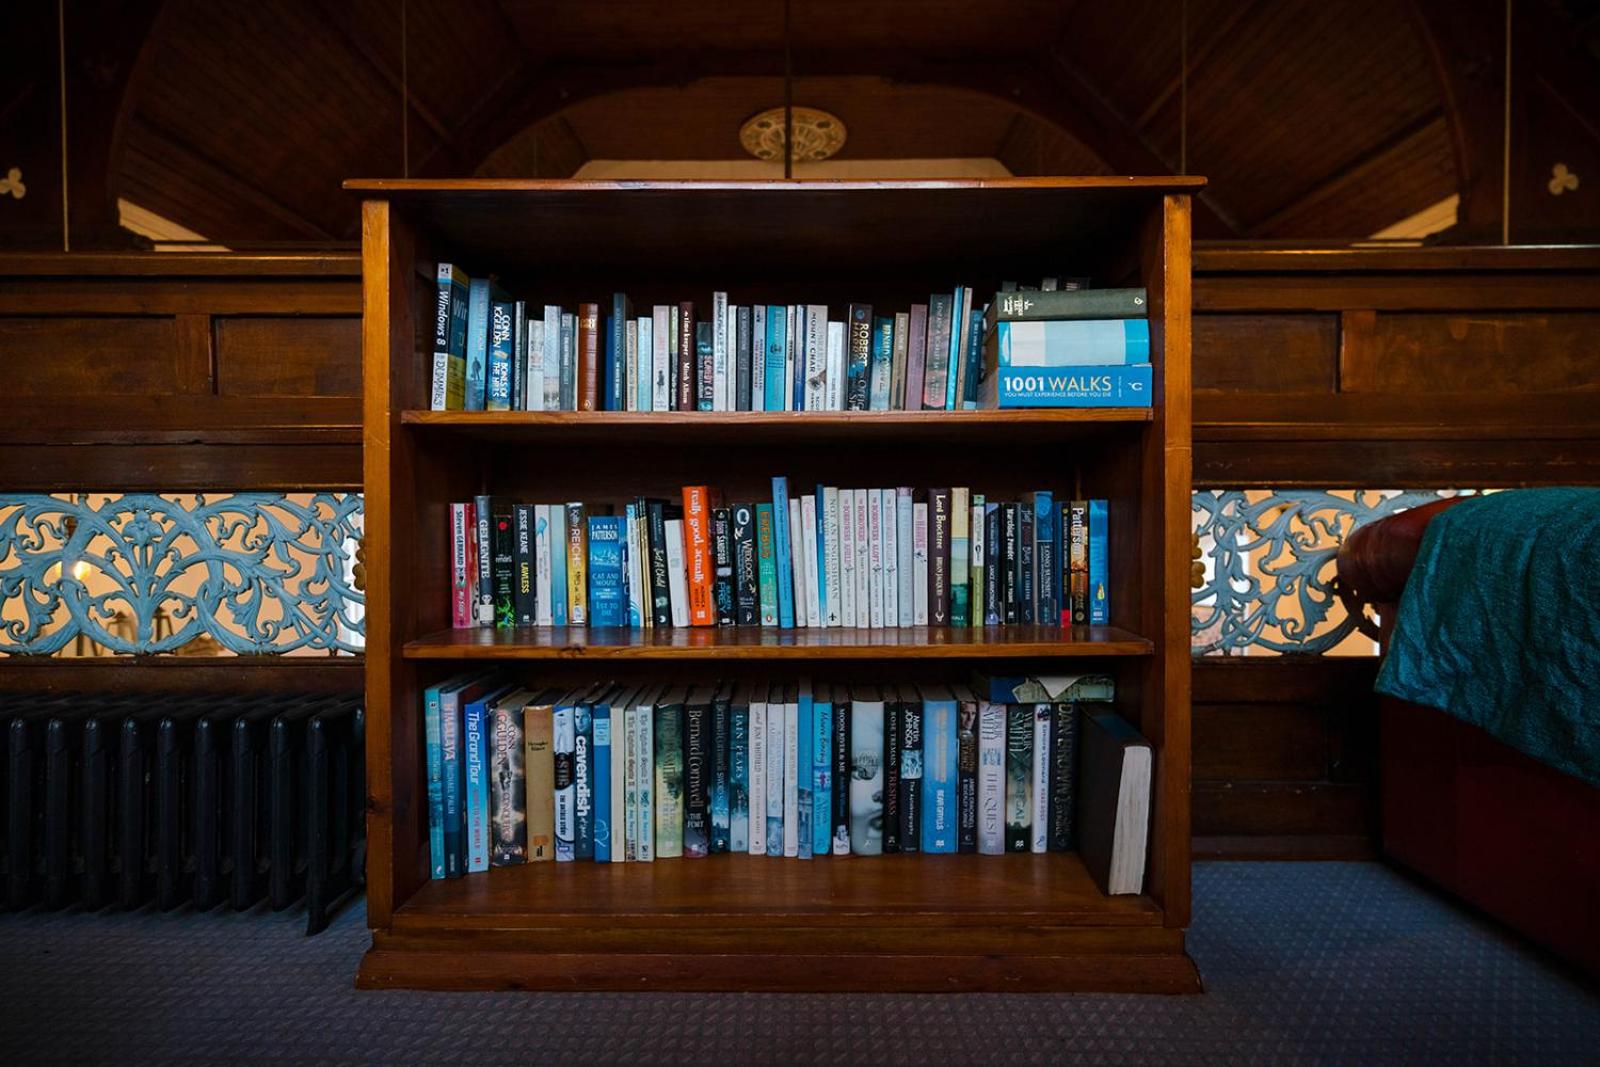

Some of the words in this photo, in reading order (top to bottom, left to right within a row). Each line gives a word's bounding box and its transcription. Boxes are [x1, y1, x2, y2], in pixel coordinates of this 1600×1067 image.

[437, 290, 449, 336] Windows
[501, 314, 511, 341] CONN
[436, 337, 446, 346] 8
[857, 323, 870, 367] ROBERT
[1004, 376, 1044, 392] 1001
[1048, 376, 1112, 392] WALKS
[518, 508, 528, 530] JESSIE
[689, 490, 700, 515] really
[935, 494, 946, 513] Lord
[478, 519, 491, 579] GELIGNITE
[694, 548, 704, 584] actually
[467, 711, 481, 731] The
[688, 710, 704, 755] Bernard
[838, 708, 846, 731] MOON
[904, 709, 914, 748] JOHNSON
[912, 715, 921, 742] Martin
[1008, 711, 1024, 752] SMITH
[468, 731, 482, 764] Grand
[469, 763, 482, 785] Tour
[575, 735, 592, 817] cavendish
[688, 756, 705, 808] Cornwell
[887, 768, 898, 816] TRESPASS
